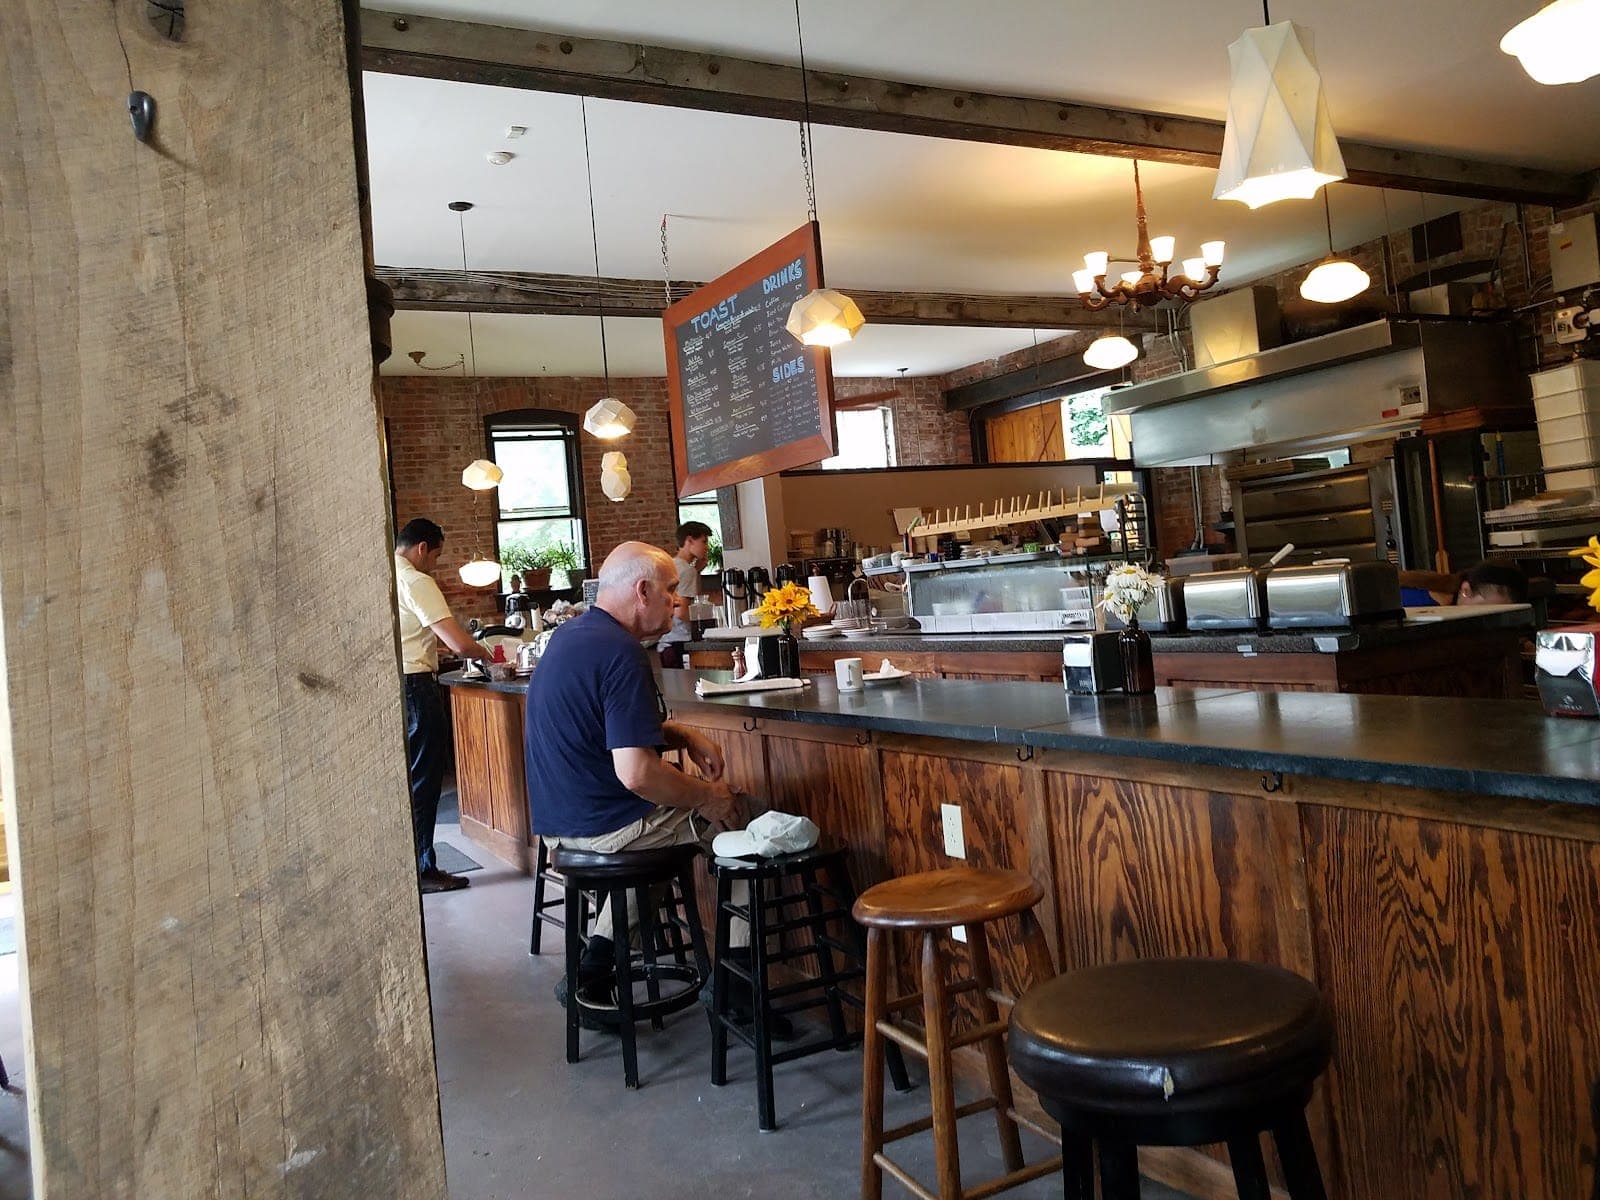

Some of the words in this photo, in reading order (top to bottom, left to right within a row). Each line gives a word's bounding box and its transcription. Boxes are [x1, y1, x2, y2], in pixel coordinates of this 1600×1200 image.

[763, 259, 803, 295] DRINKS
[690, 294, 738, 334] TOAST
[773, 356, 805, 383] SIDES
